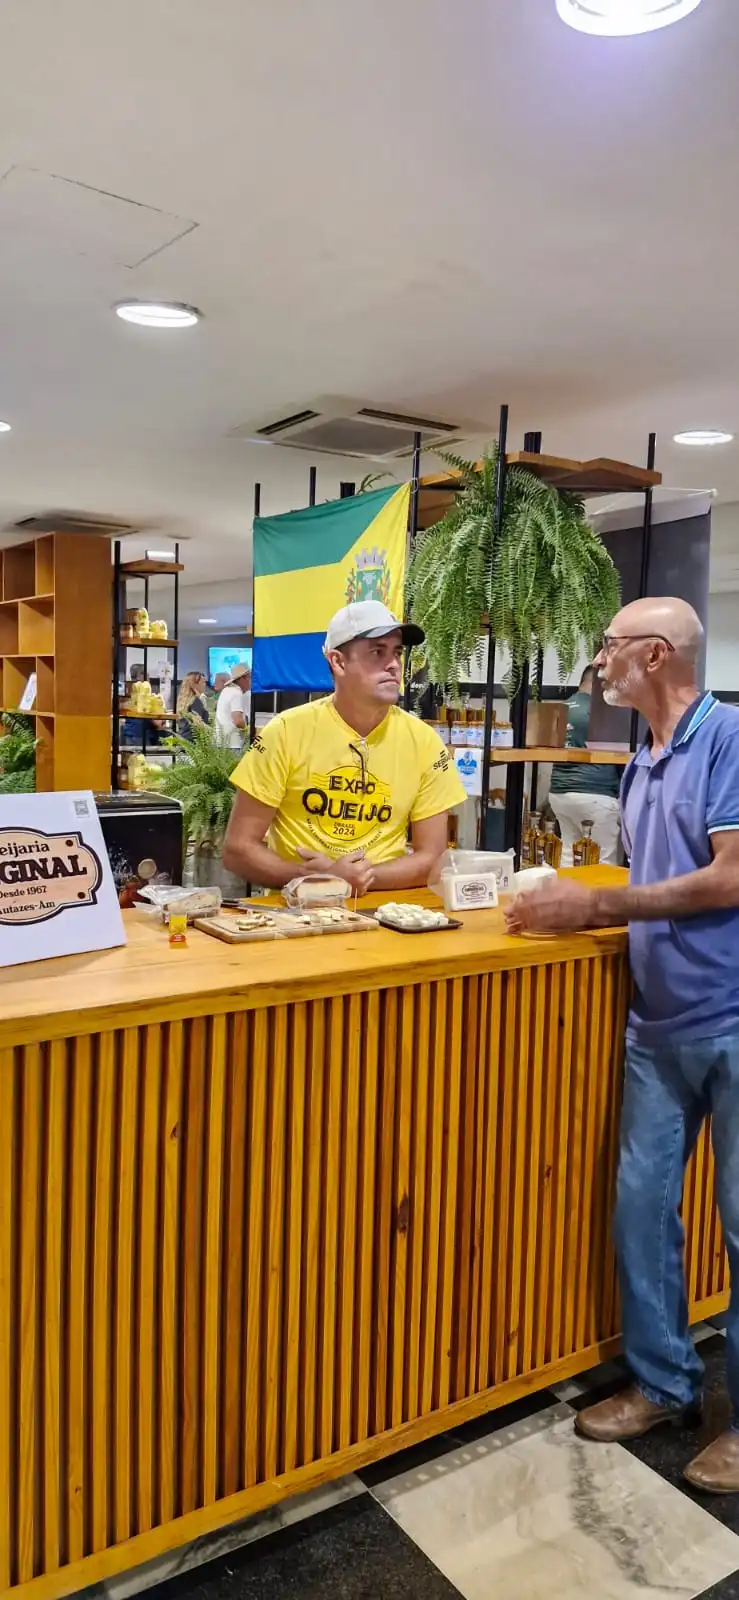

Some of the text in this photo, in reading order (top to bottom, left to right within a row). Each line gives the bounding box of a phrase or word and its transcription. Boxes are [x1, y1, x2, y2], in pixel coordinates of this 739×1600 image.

[329, 775, 376, 794] EXPO
[302, 787, 393, 822] QUEIJO
[332, 826, 355, 836] 2024
[27, 885, 47, 895] 1967
